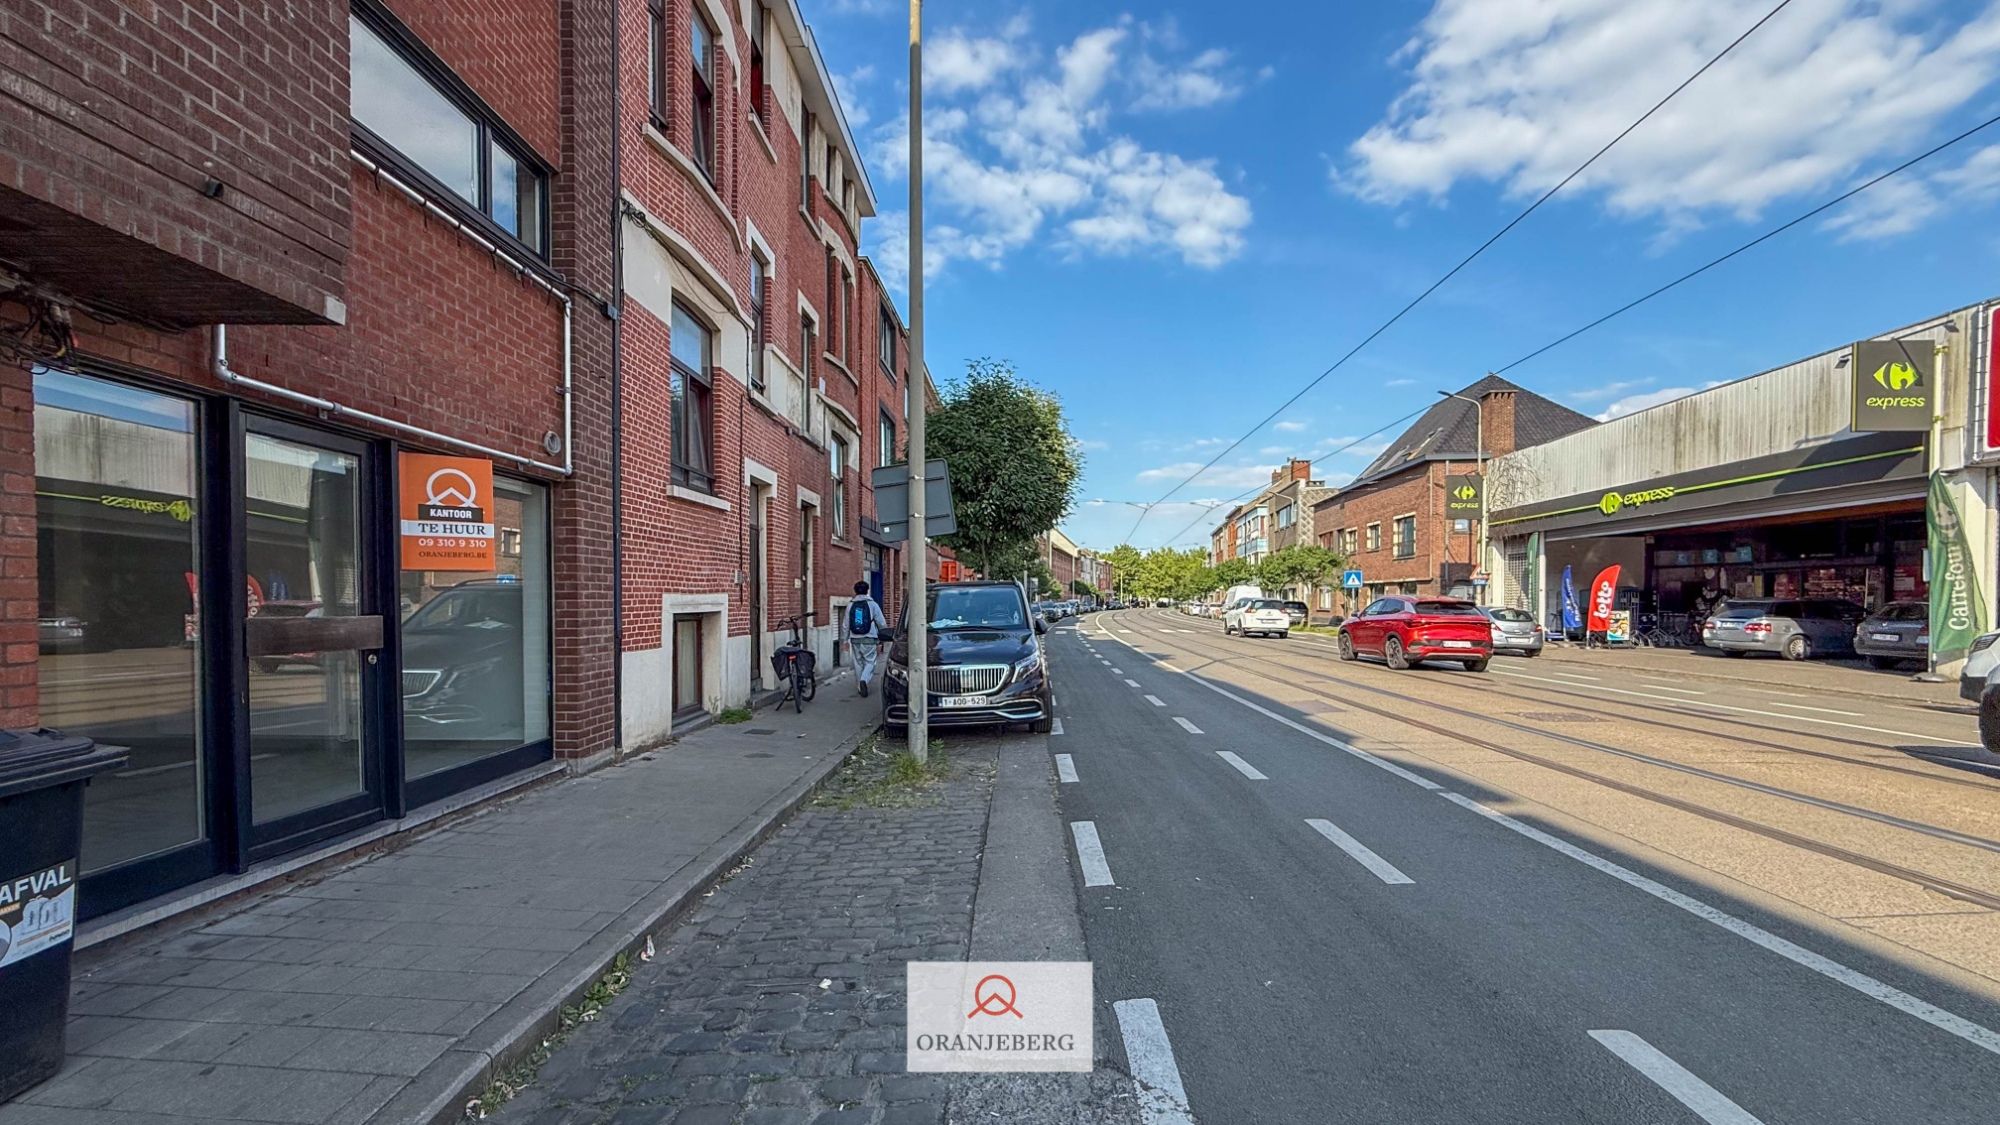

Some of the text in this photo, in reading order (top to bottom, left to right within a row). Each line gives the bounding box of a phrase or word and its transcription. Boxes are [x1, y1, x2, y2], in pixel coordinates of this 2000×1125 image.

[1866, 396, 1926, 410] express
[1623, 486, 1675, 507] express
[430, 508, 472, 519] KANTOOR
[418, 522, 486, 535] TE HUUR
[418, 538, 487, 548] 09 310 9 310
[418, 550, 487, 559] ORANJEBERG.BE
